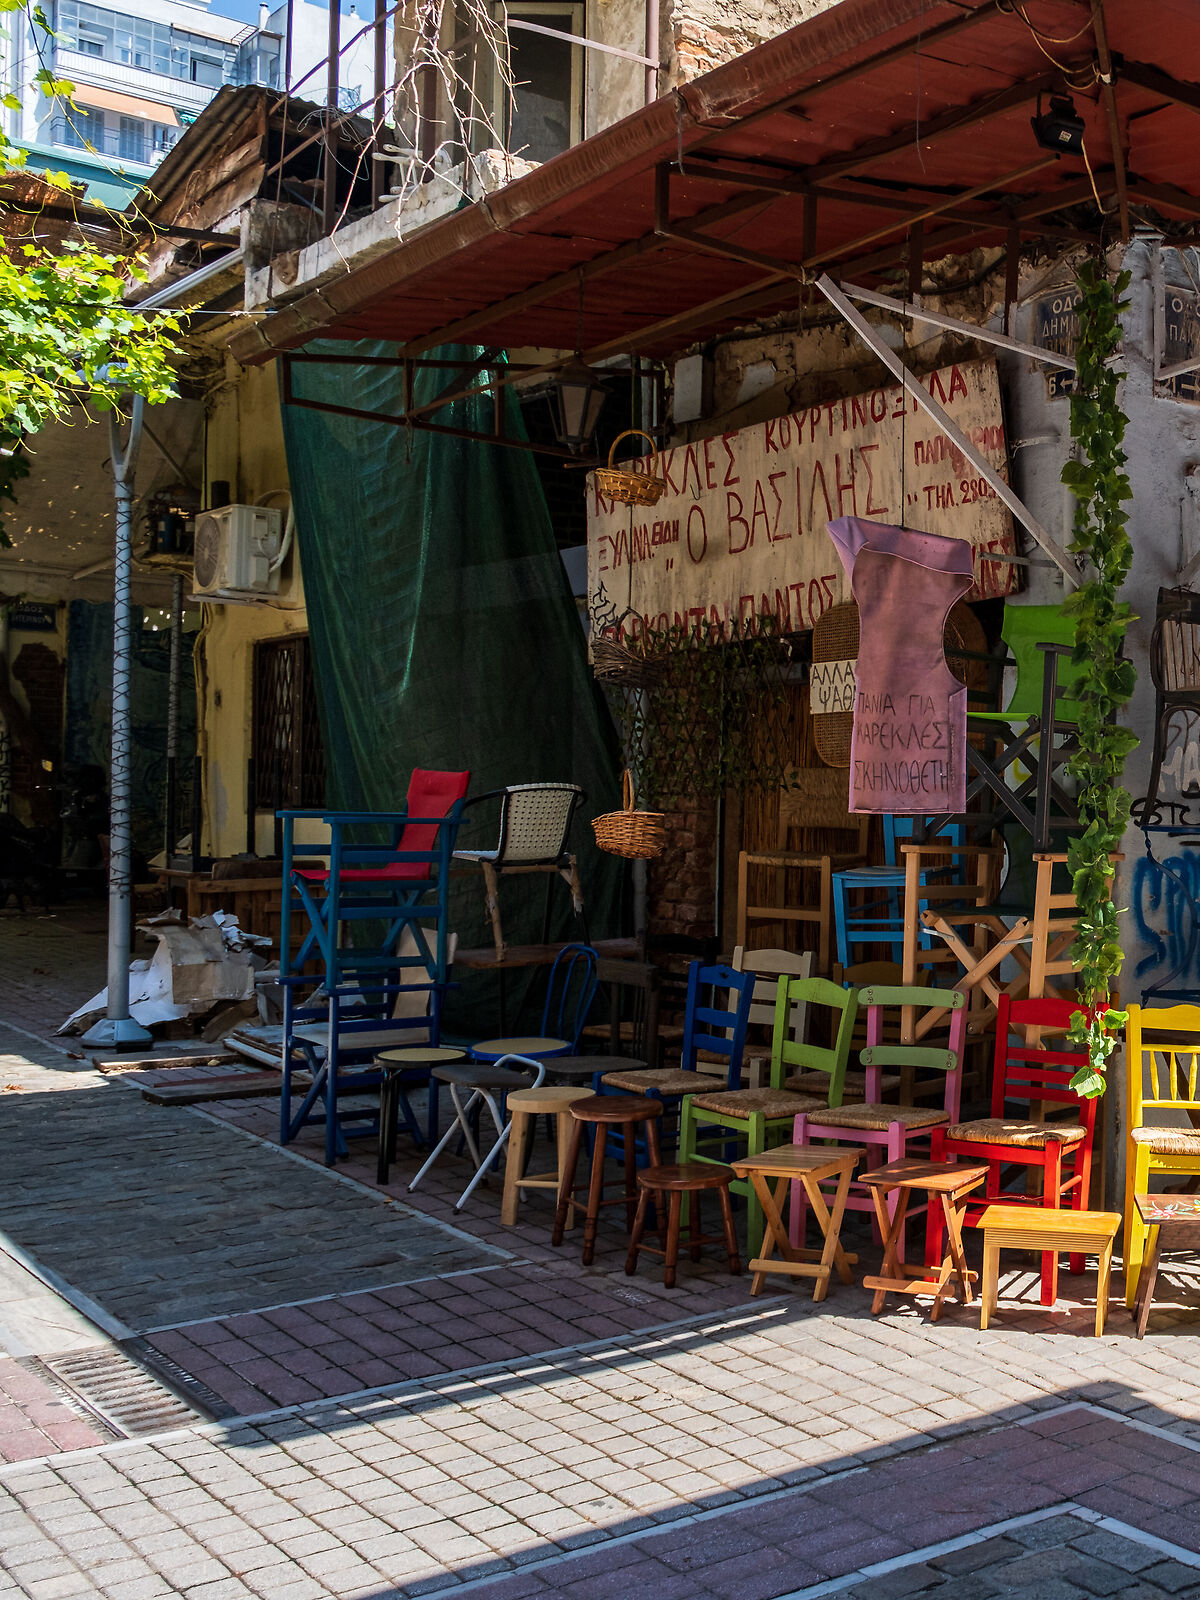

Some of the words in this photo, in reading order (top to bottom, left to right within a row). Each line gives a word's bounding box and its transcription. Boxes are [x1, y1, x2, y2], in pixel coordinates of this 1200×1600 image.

[1052, 294, 1084, 314] ΟΔΟ
[727, 443, 889, 555] ΒΑΣΙΛΗΣ
[597, 523, 655, 572] ΞΥΛΝΑ.
[858, 692, 896, 716] ΠΑΝΙΑ
[908, 694, 936, 715] ΓΙΑ
[856, 720, 950, 751] ΚΑΡΕΚΛΕΣ
[854, 760, 950, 795] ΣΚΗΝΟΘΕΤΗ
